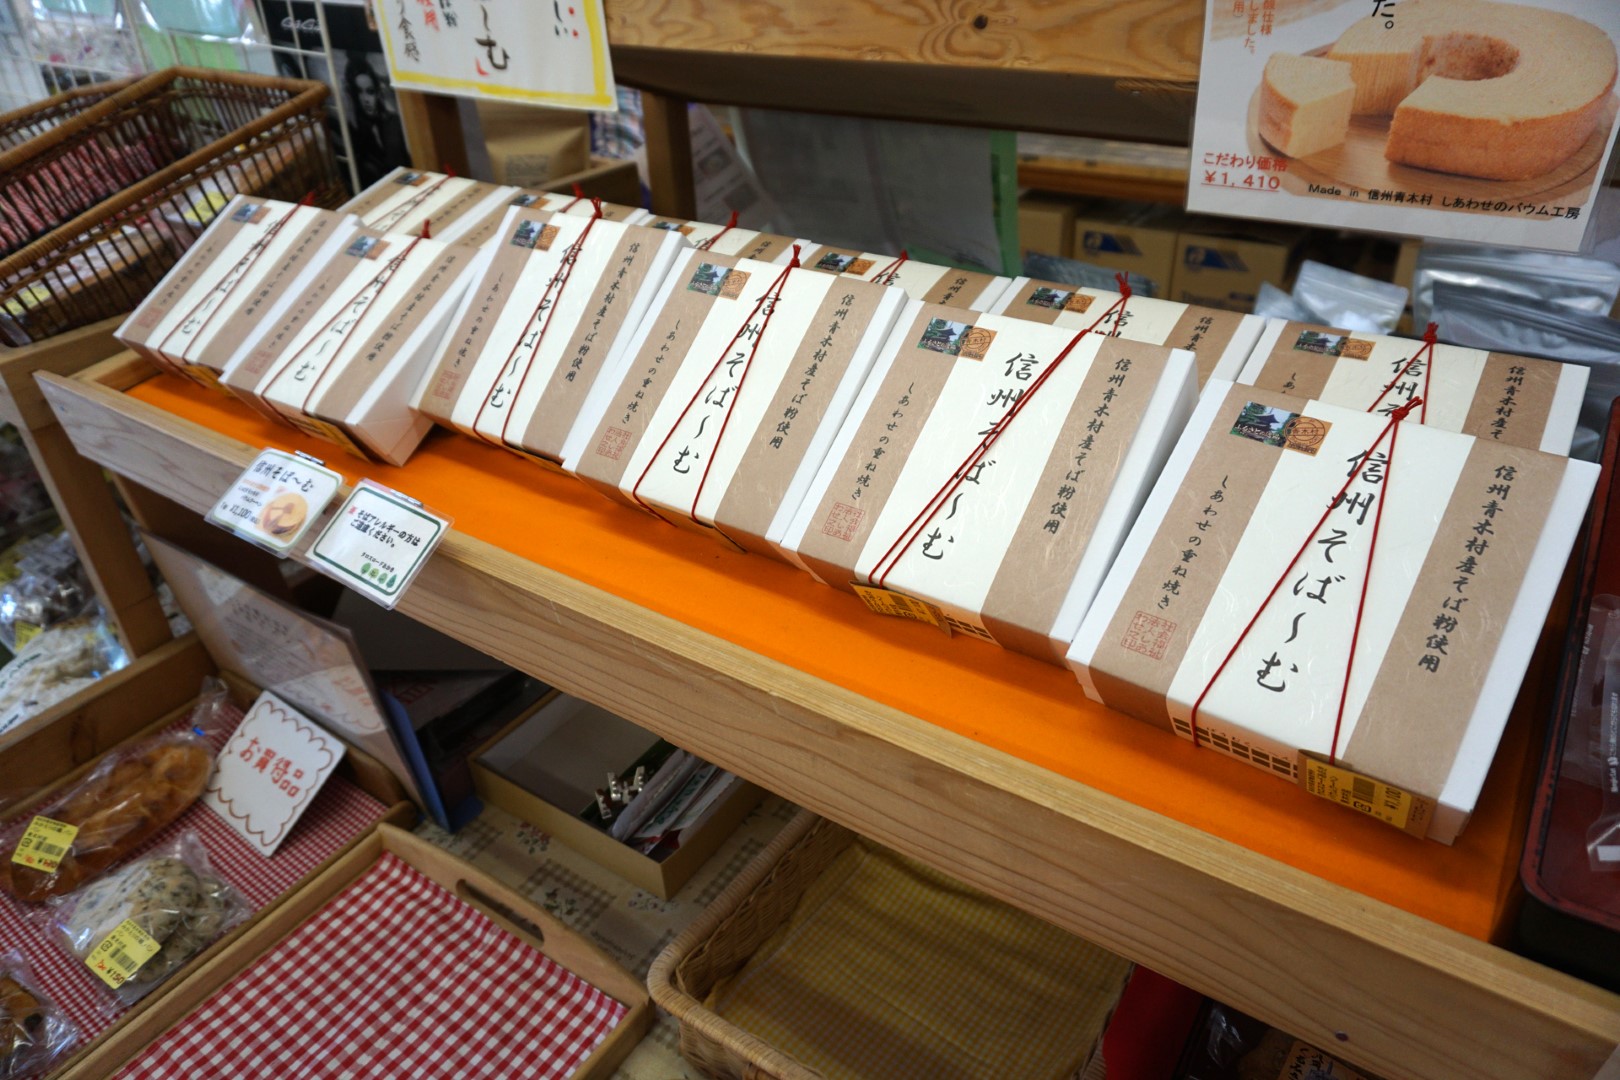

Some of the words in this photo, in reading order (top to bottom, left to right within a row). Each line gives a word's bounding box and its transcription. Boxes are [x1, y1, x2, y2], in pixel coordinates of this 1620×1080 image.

[1203, 151, 1289, 173] こだわり価格
[1308, 183, 1342, 197] Made
[1350, 188, 1359, 198] in
[1367, 188, 1433, 206] 信州青木村
[1441, 195, 1582, 220] しあわせのバウム工房
[1418, 464, 1518, 673] 信州青木村産そば粉使用
[239, 736, 305, 798] お買得品
